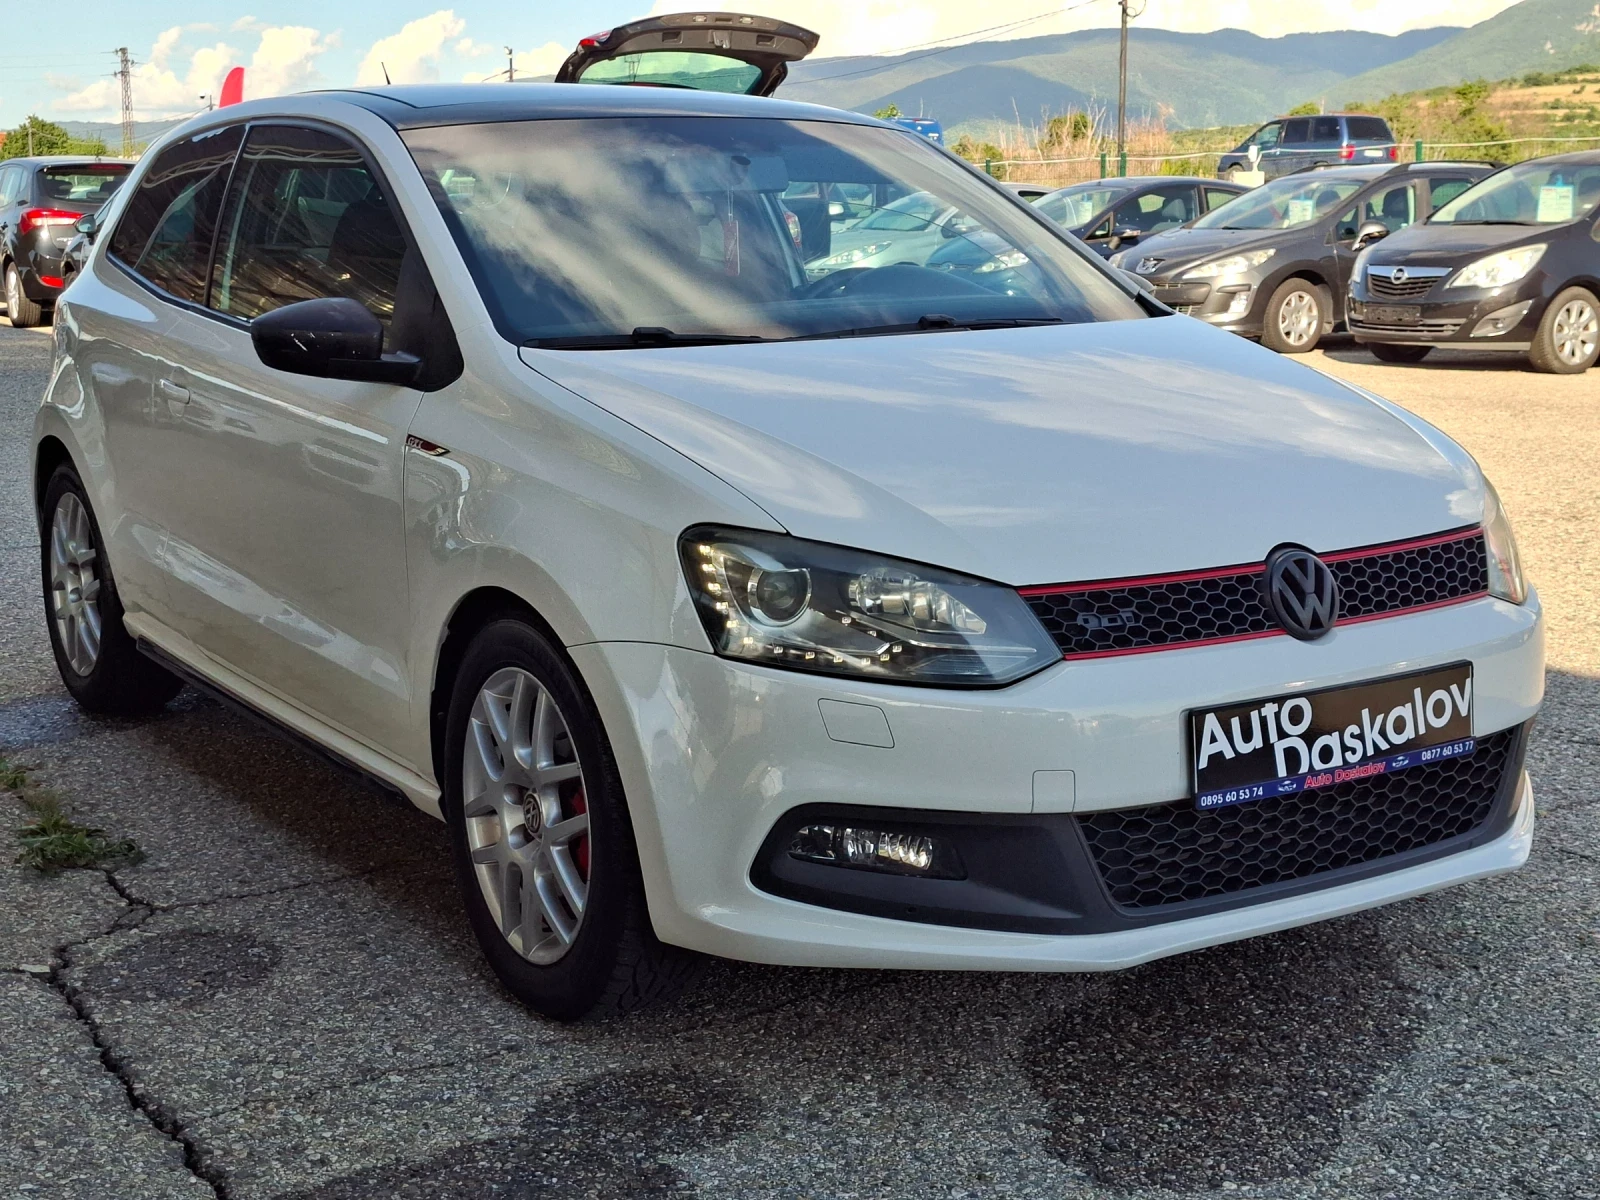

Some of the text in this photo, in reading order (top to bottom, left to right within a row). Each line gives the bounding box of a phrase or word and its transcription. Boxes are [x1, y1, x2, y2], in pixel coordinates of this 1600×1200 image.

[1198, 697, 1313, 771] Auto
[1273, 677, 1472, 778] Daskalov
[1201, 740, 1474, 807] 0895 60 53 74 Auto Daskalov 0877 60 53 77
